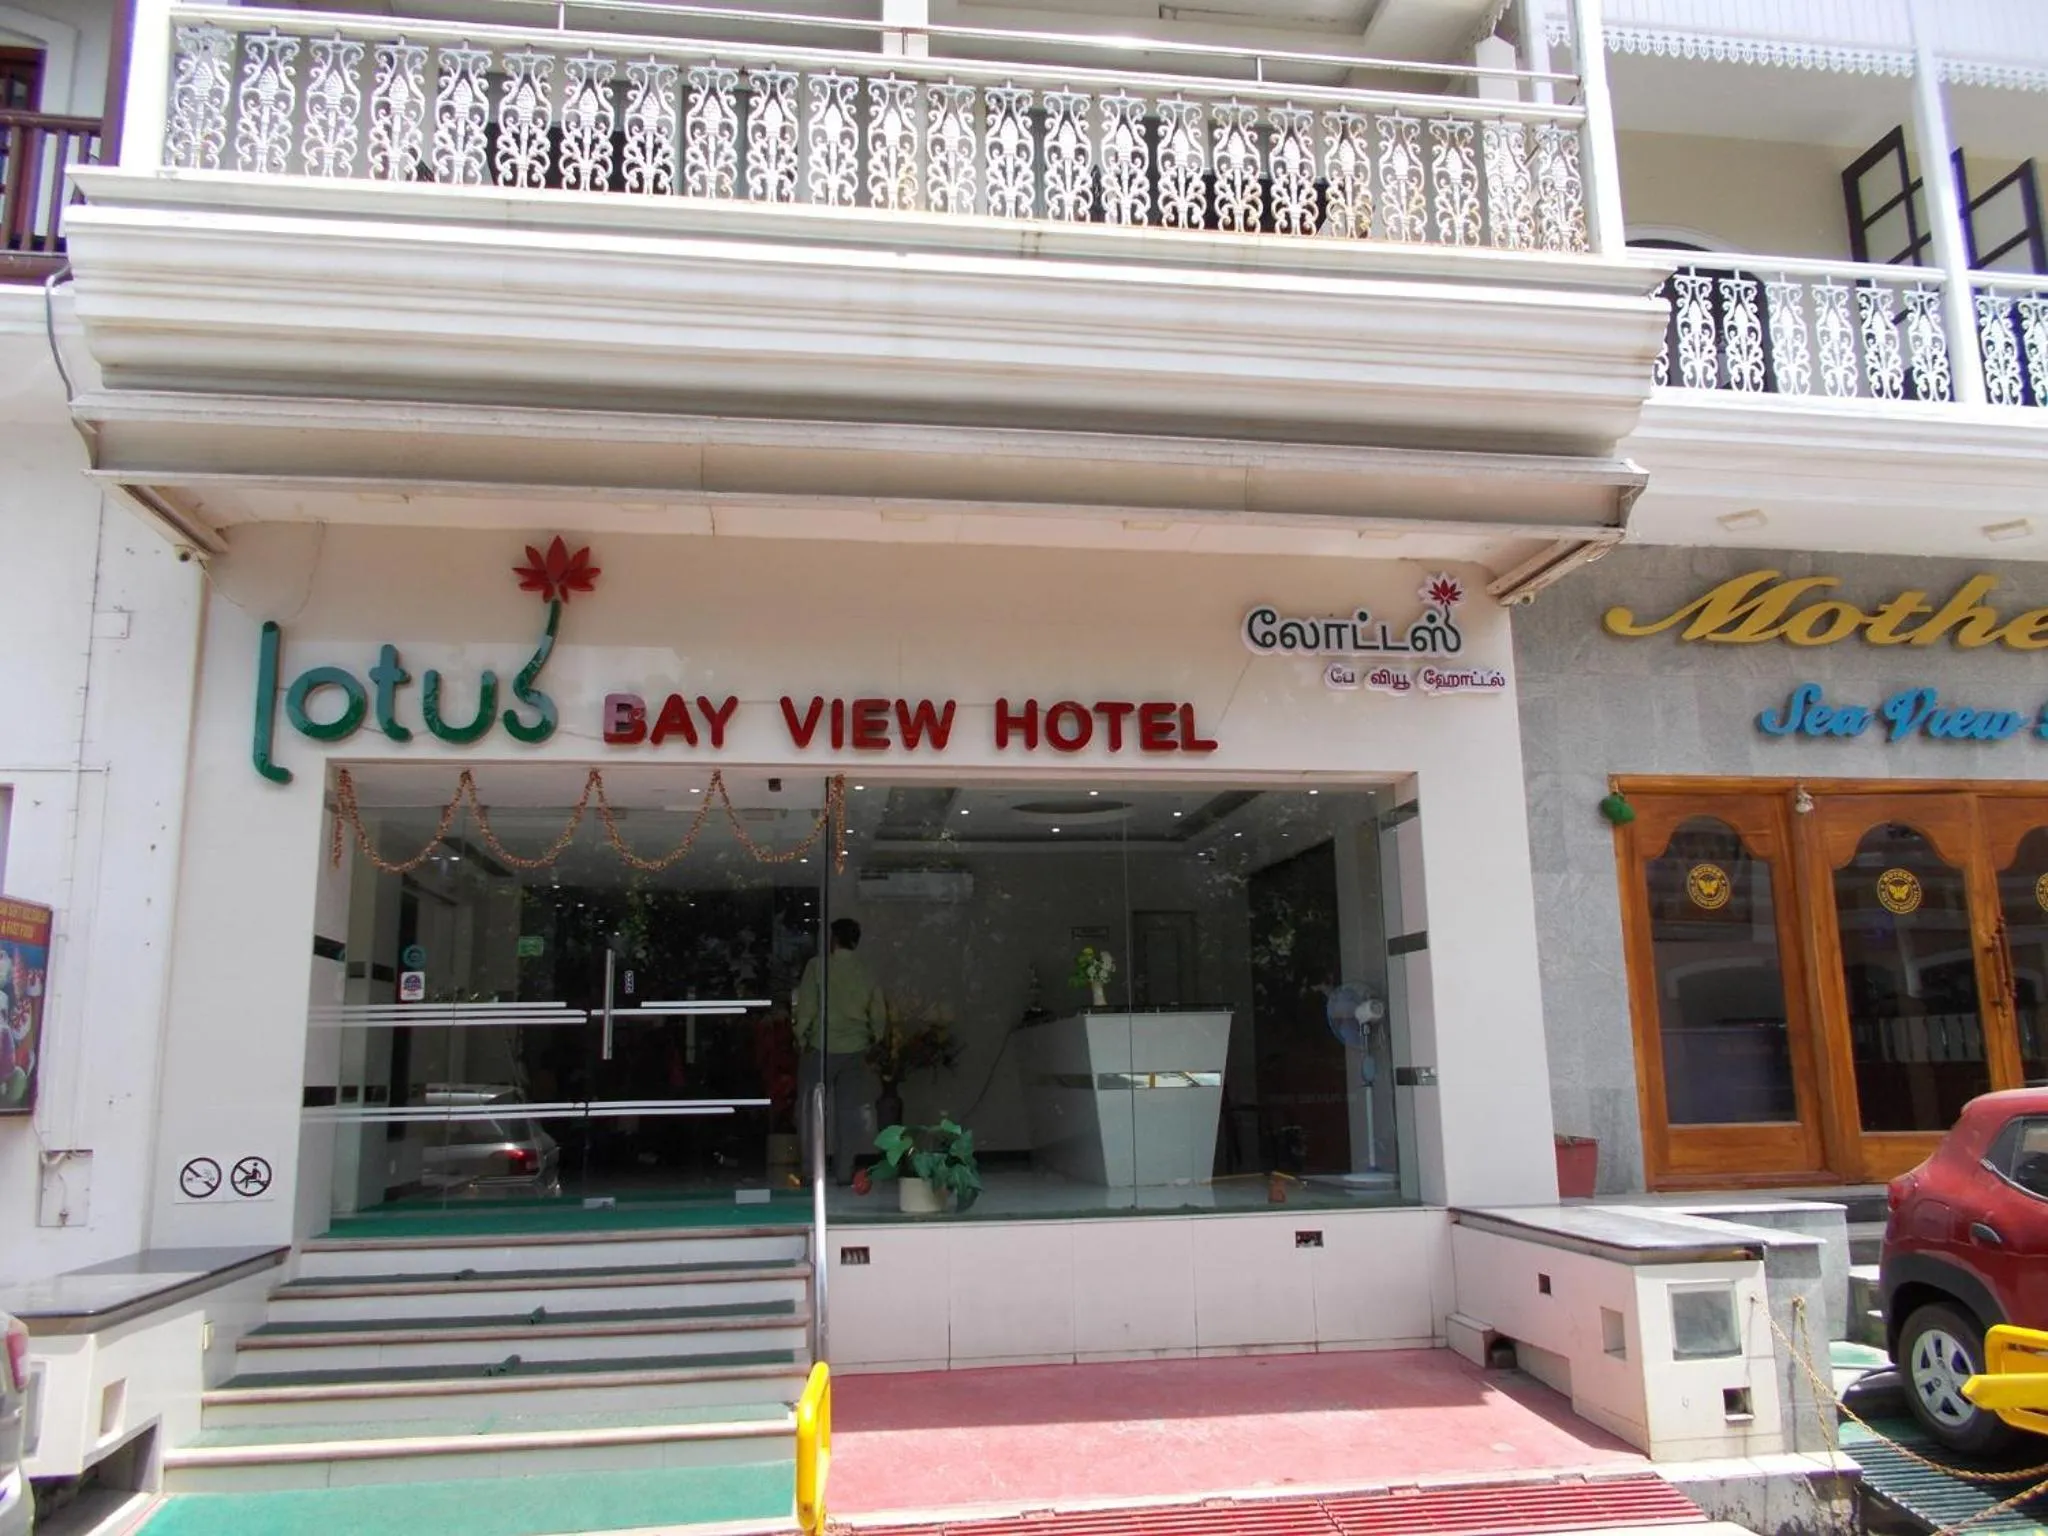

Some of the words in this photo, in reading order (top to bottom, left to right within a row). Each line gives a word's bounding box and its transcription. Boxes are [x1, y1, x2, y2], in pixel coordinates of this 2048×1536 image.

[1247, 606, 1463, 653] லோட்டஸ்
[253, 600, 560, 785] lotus
[602, 692, 739, 749] BAY
[779, 694, 957, 751] VIEW
[994, 696, 1219, 753] HOTEL
[1330, 668, 1355, 684] பே
[1759, 682, 1873, 738] Sea
[1882, 686, 2022, 743] View
